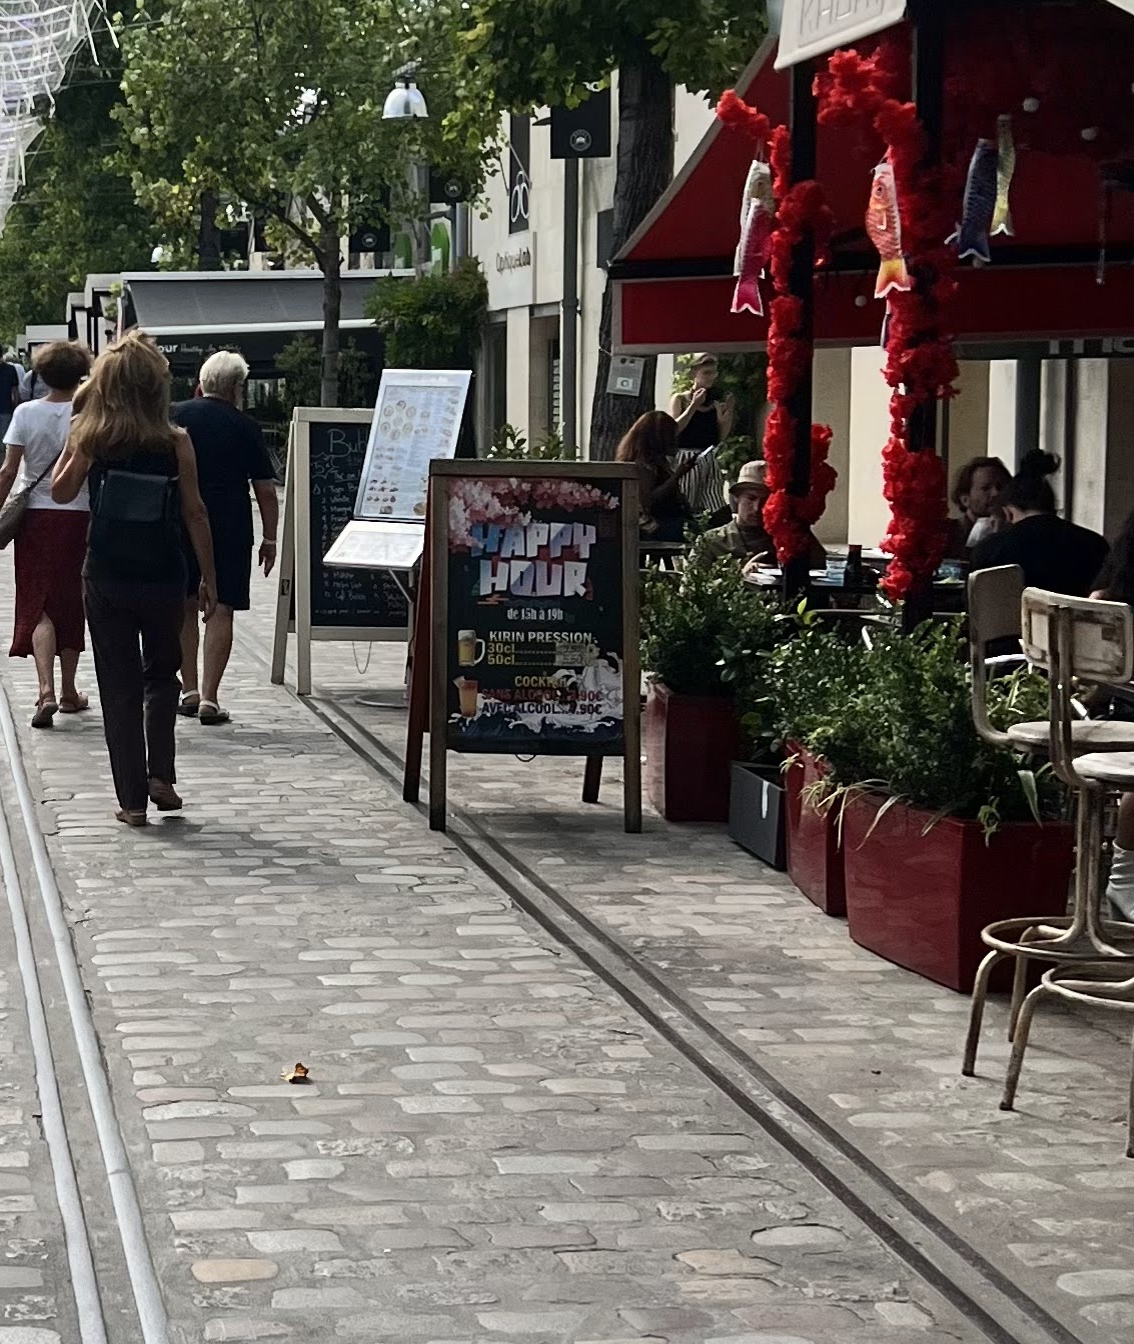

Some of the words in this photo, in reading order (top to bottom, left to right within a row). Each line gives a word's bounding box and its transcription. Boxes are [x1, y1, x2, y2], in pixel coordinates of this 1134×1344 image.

[471, 522, 596, 558] HAPPY
[480, 560, 587, 597] HOUR
[507, 608, 519, 620] de
[521, 608, 537, 620] 15h
[547, 608, 564, 620] 19h
[489, 631, 525, 642] KIRIN
[528, 631, 593, 644] PRESSION
[487, 643, 515, 654] 30cl
[487, 655, 515, 666] 50cl
[482, 702, 512, 714] AVEC
